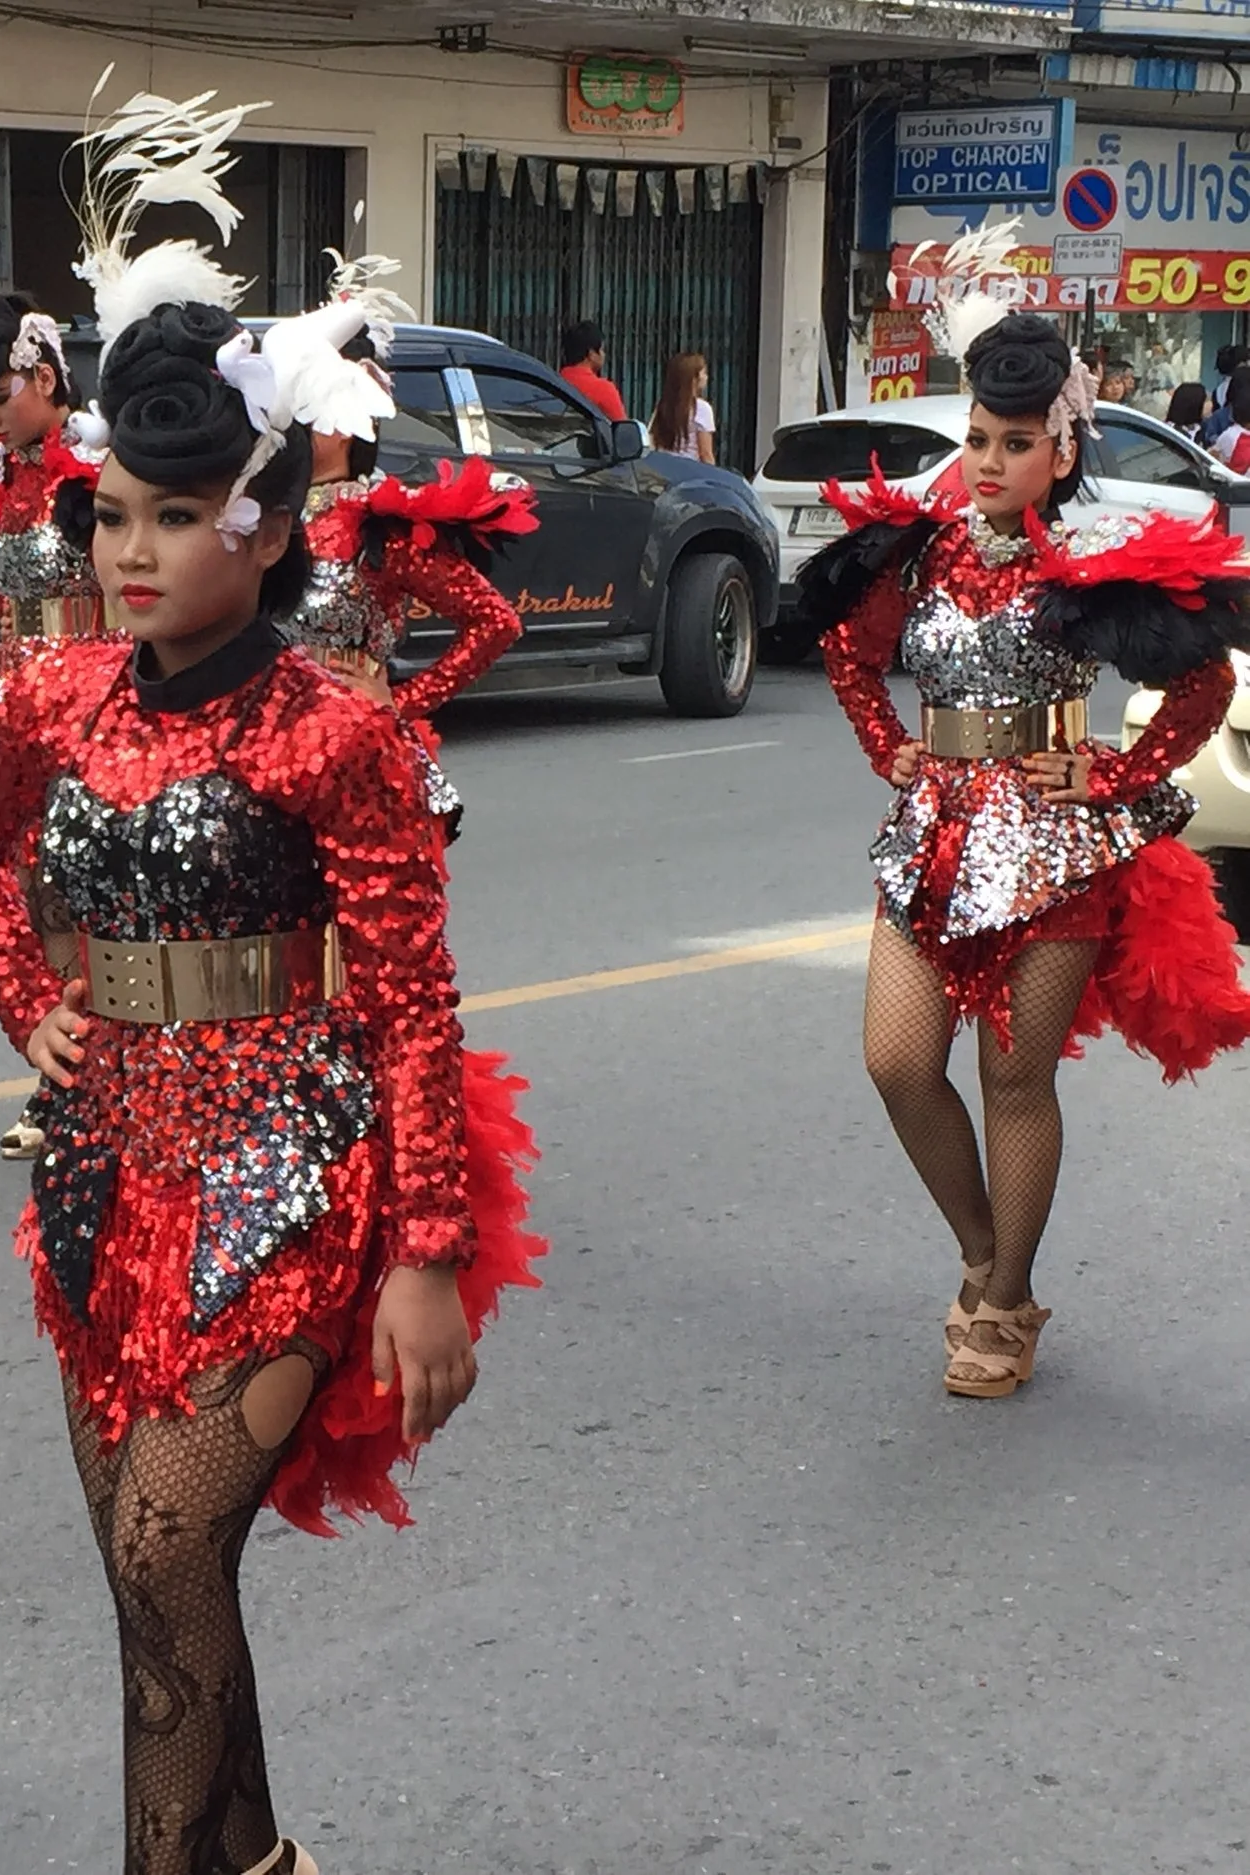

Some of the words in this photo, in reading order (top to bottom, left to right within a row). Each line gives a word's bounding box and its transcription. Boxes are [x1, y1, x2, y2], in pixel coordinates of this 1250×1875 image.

[900, 149, 938, 168] TOP
[951, 144, 1047, 168] CHAROEN
[912, 171, 1028, 194] OPTICAL
[517, 583, 614, 614] trakul
